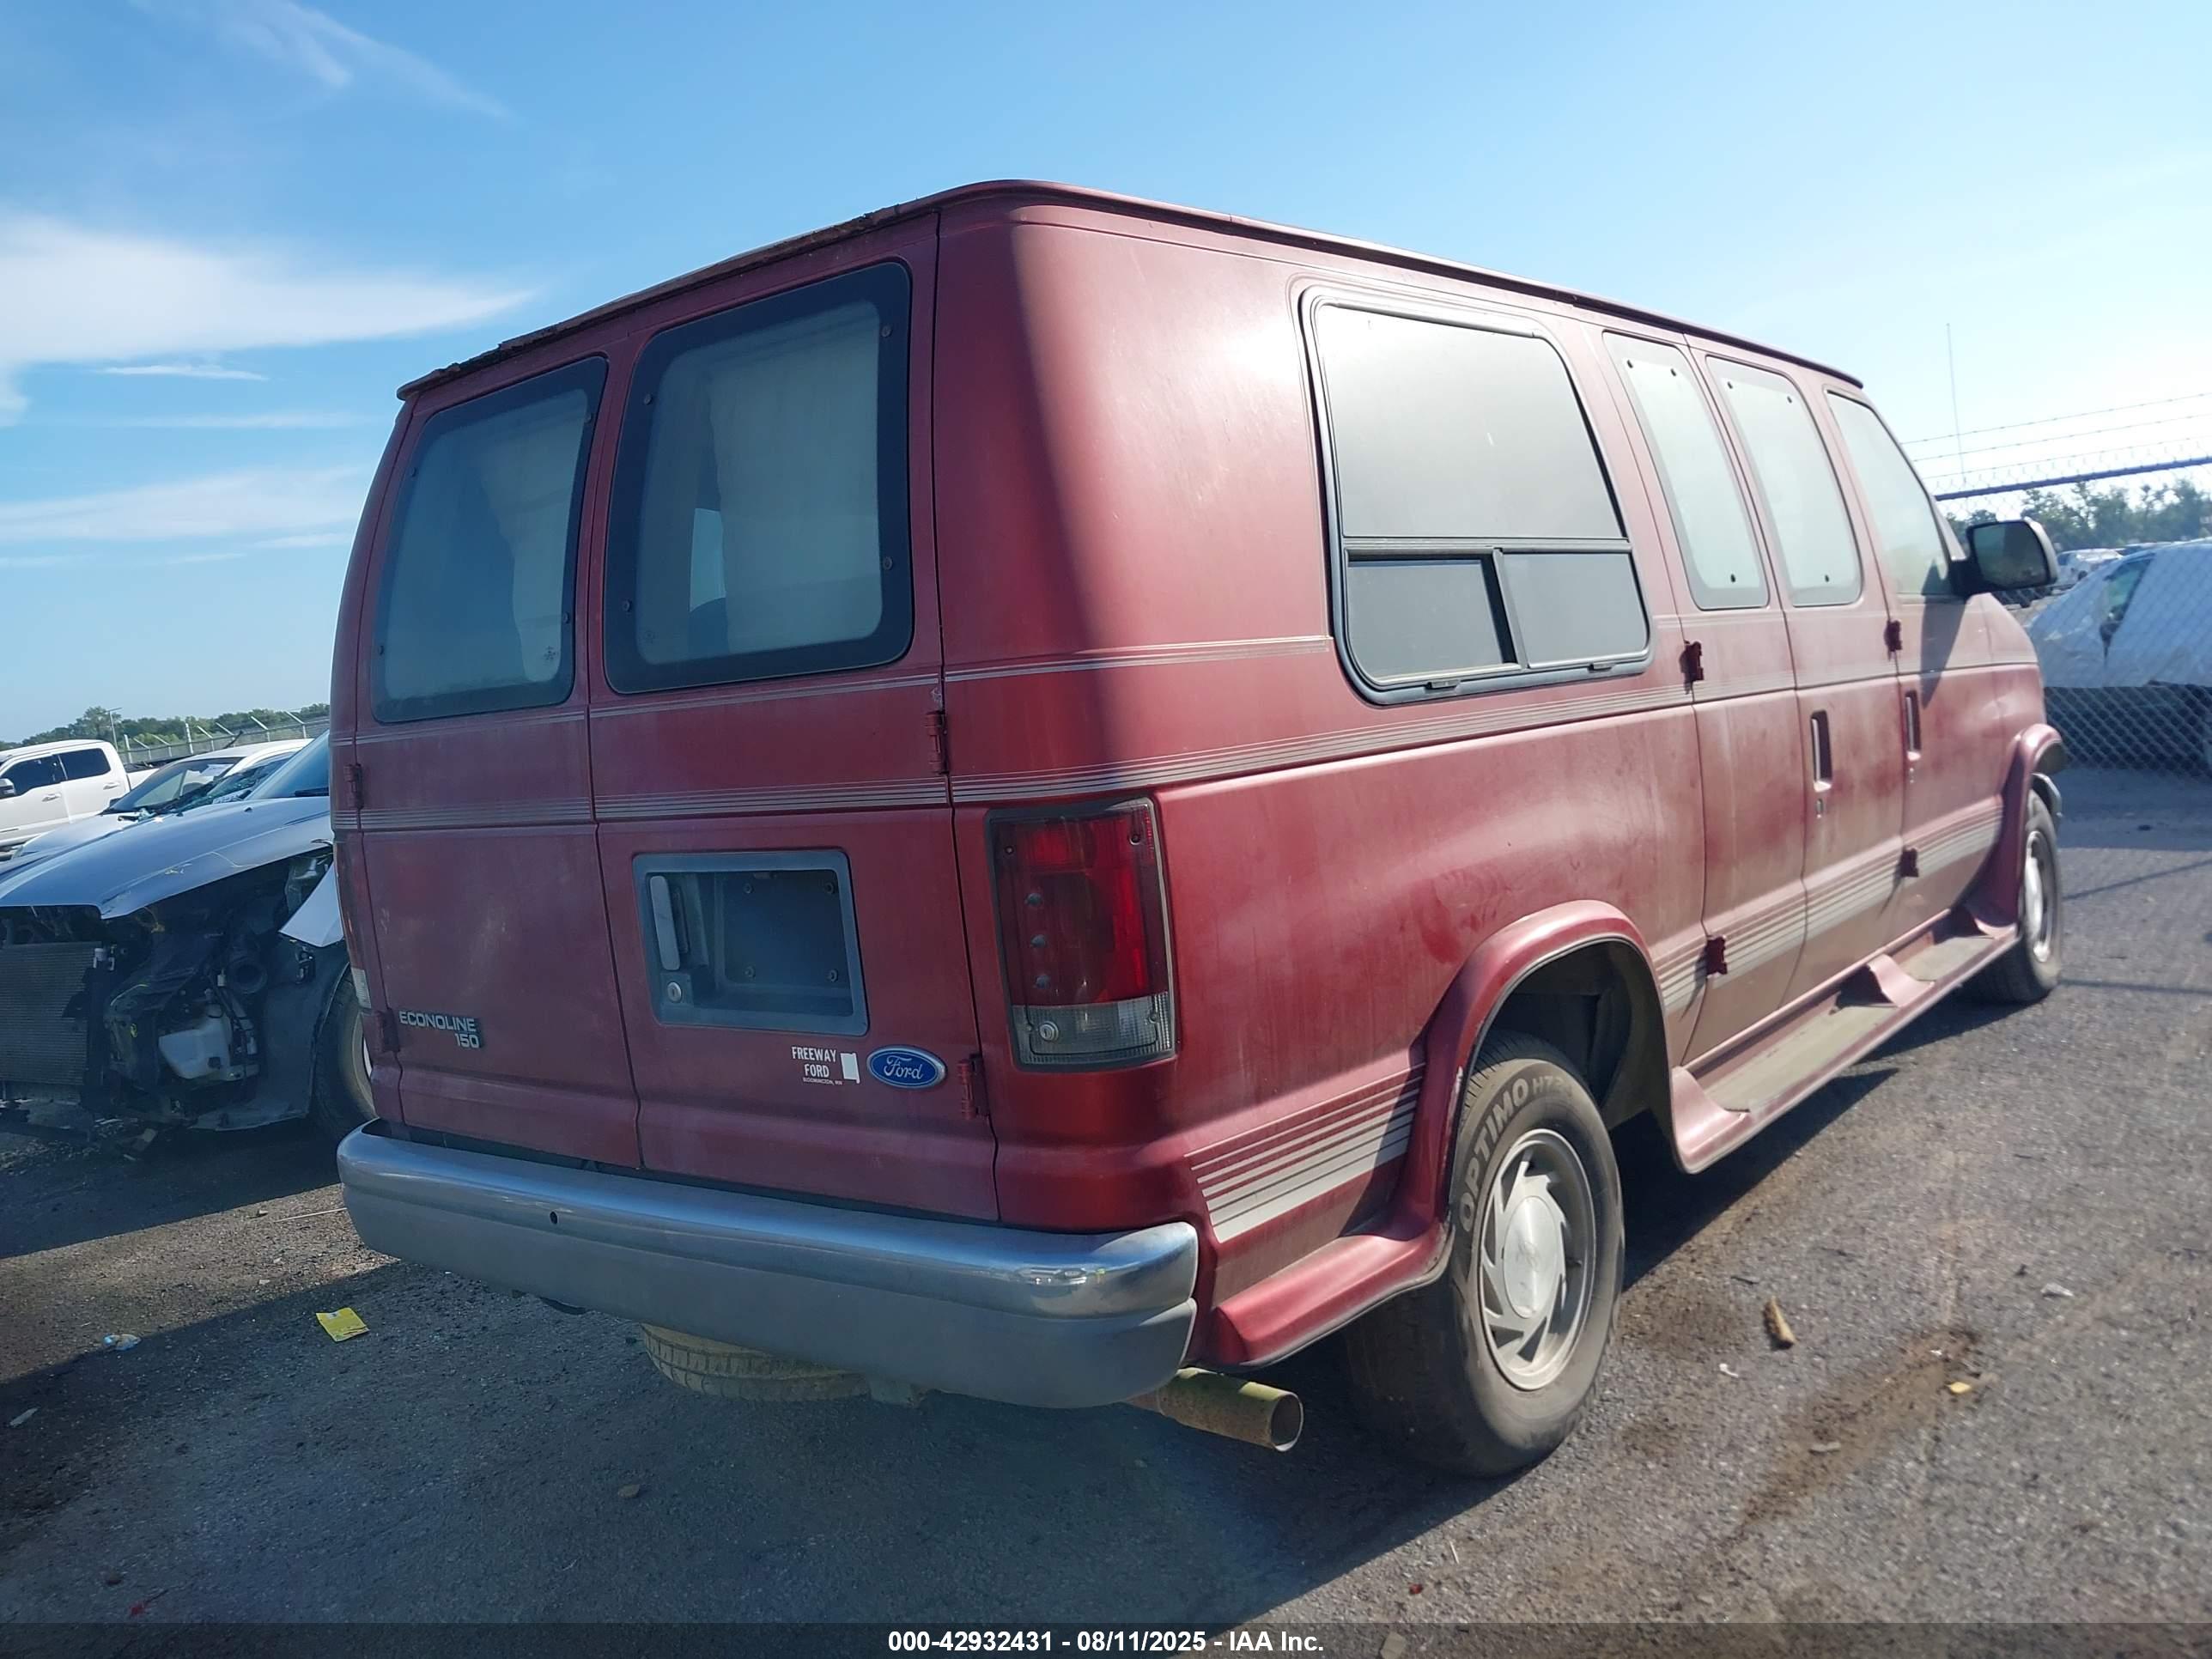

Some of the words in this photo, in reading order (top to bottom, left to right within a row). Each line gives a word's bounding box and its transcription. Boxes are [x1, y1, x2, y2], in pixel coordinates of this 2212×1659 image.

[399, 1011, 477, 1032] ECONOLINE
[454, 1033, 480, 1048] 150
[792, 1046, 837, 1062] FREEWAY
[804, 1063, 830, 1078] FORD
[883, 1054, 925, 1079] Ford
[1459, 1078, 1529, 1232] OPTIMO
